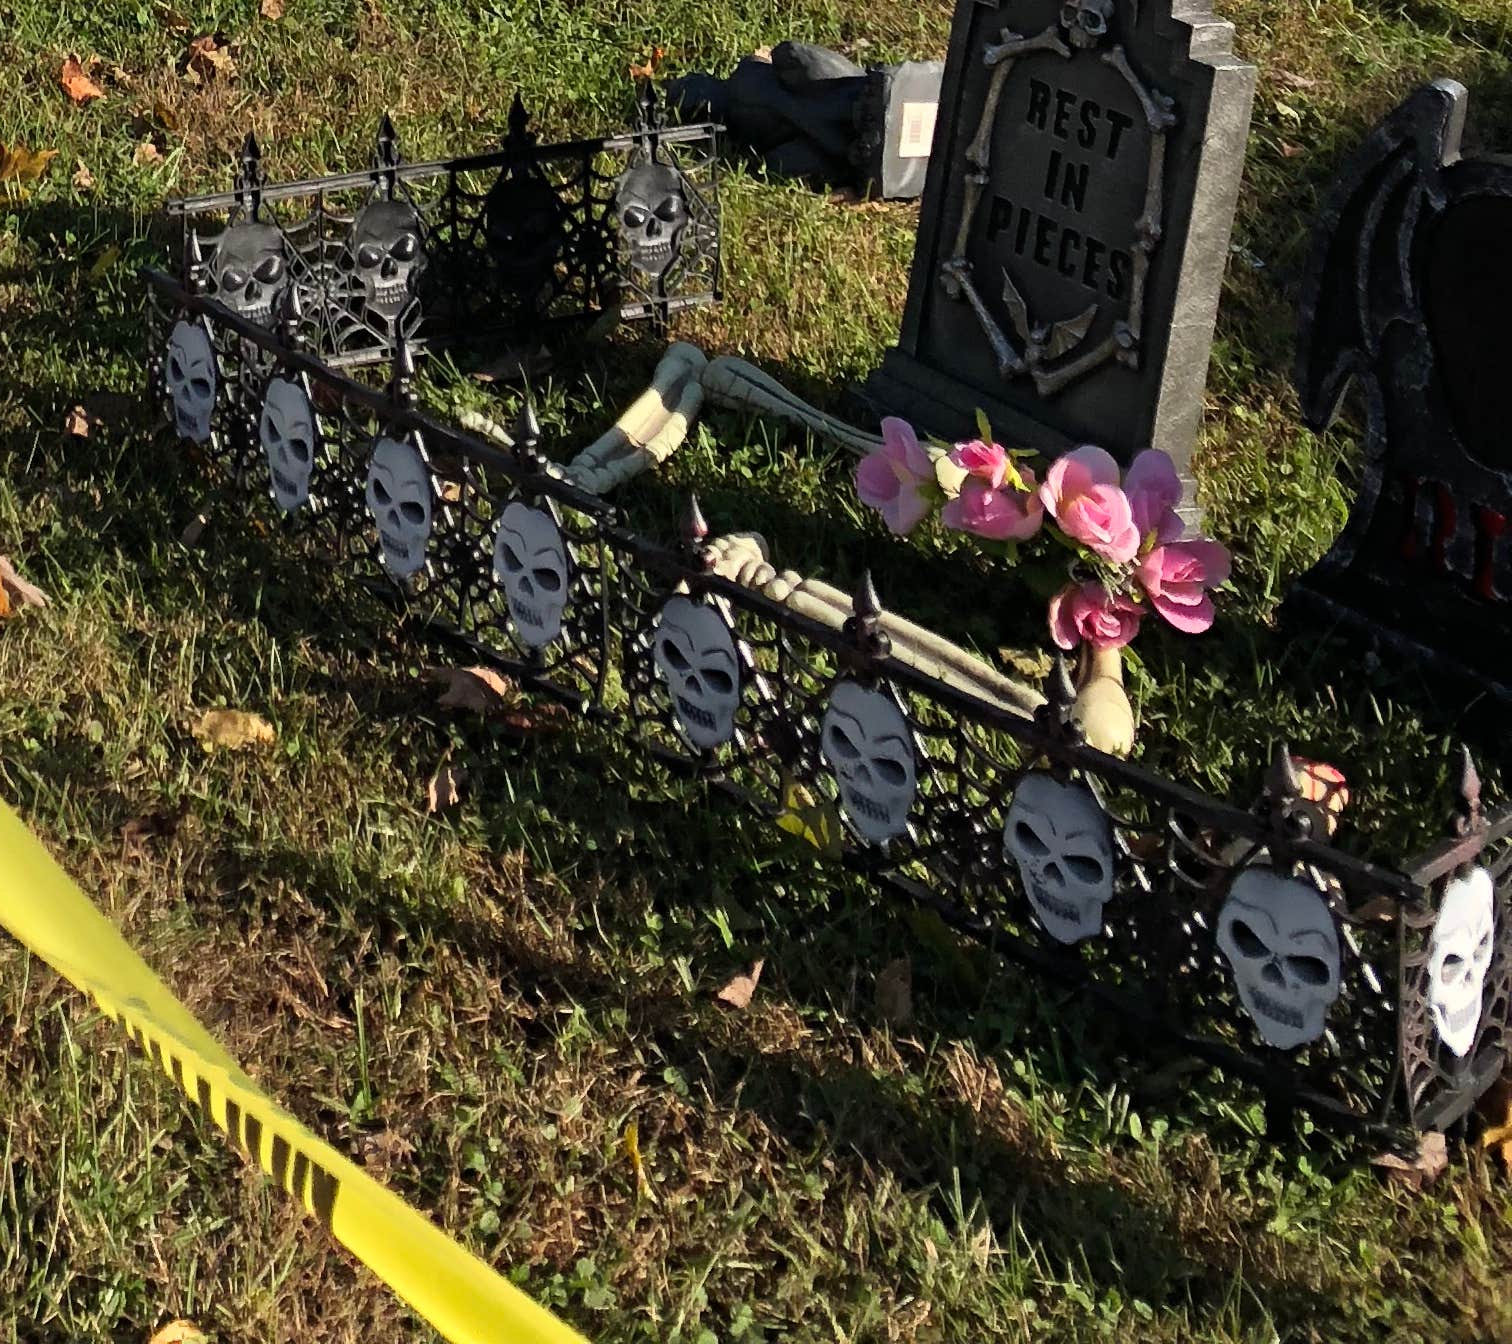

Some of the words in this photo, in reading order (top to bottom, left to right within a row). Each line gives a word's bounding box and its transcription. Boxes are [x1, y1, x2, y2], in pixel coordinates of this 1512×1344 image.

[1025, 76, 1134, 161] REST
[1043, 148, 1090, 214] IN
[985, 195, 1133, 301] PIECES
